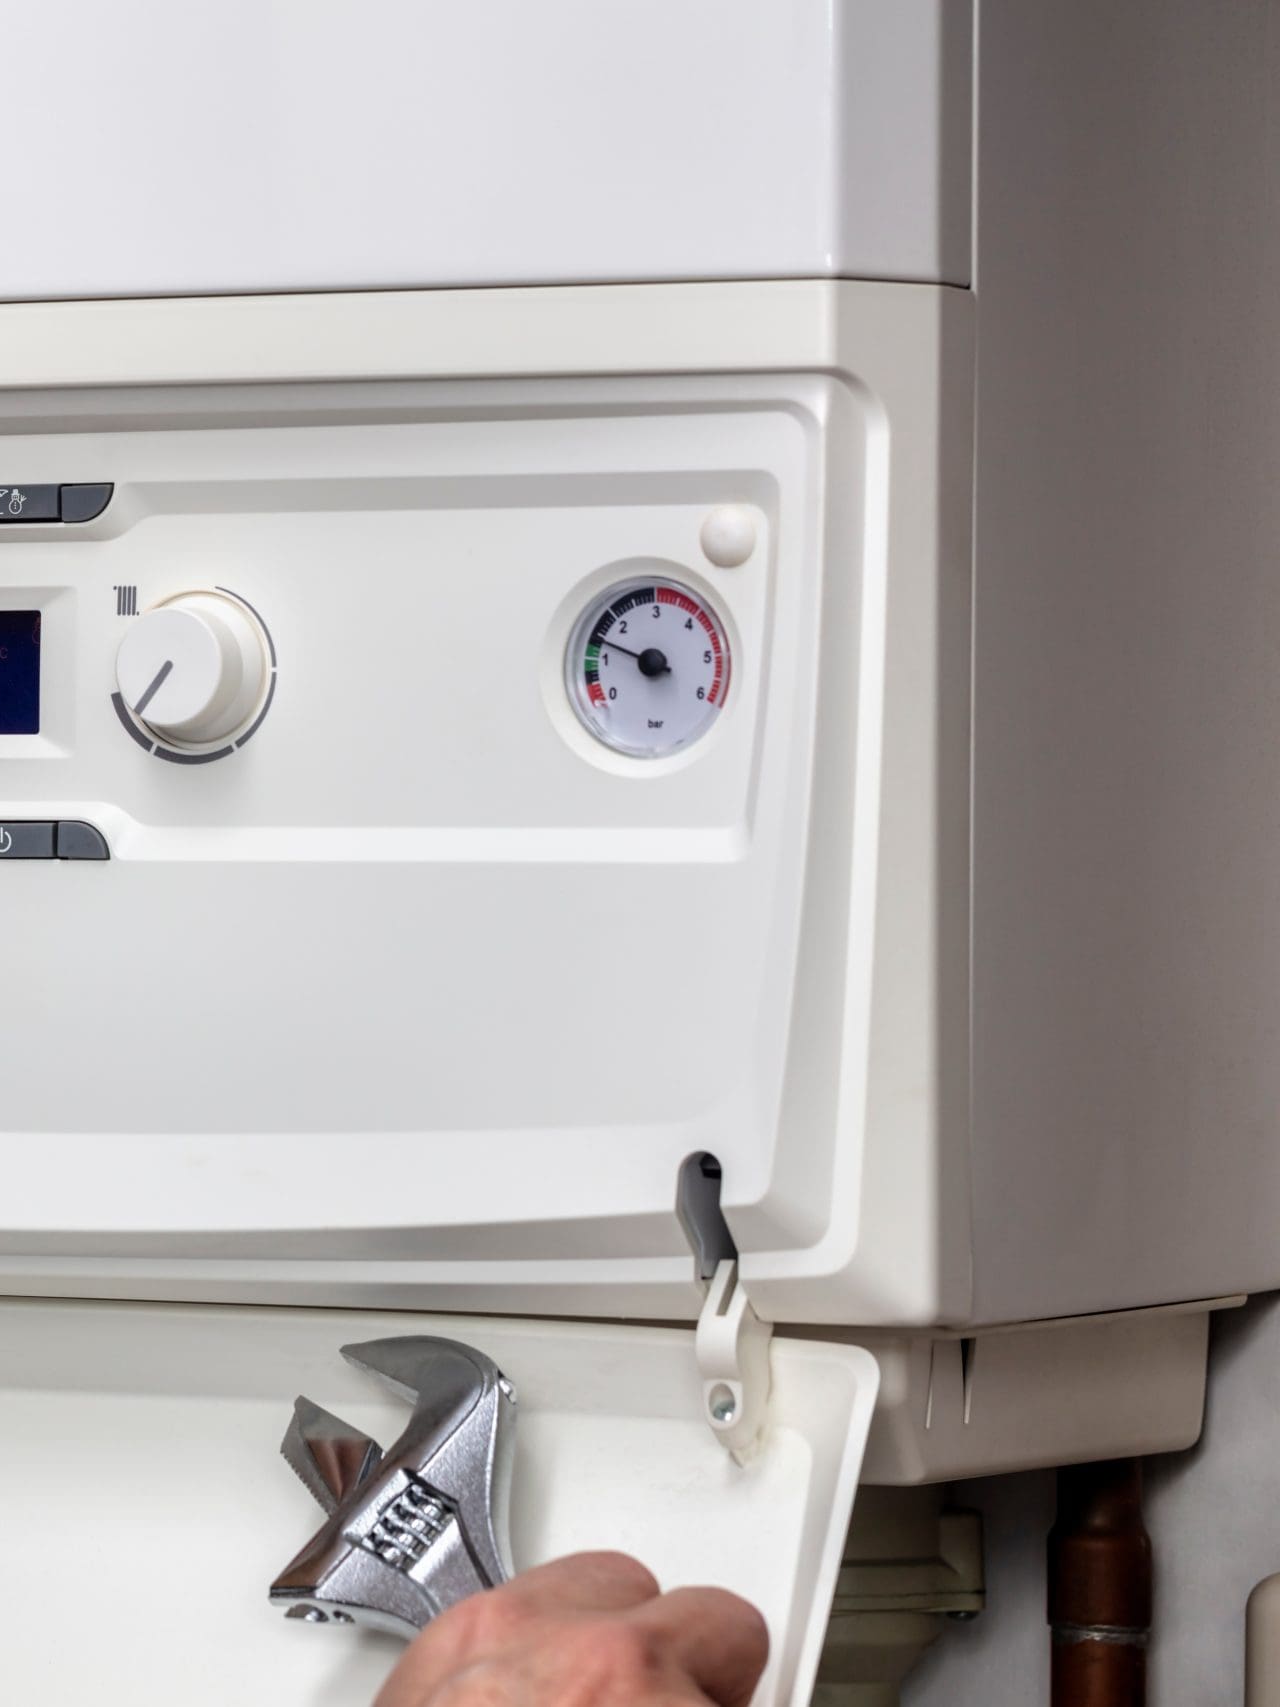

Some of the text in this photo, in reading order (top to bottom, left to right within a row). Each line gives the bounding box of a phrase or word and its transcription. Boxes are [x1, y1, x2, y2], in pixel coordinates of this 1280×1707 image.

[652, 605, 661, 618] 3
[620, 620, 628, 633] 2
[684, 617, 693, 630] 4
[602, 652, 608, 666] 1
[704, 650, 712, 663] 5
[609, 687, 617, 700] 0
[696, 687, 704, 699] 6
[648, 719, 664, 728] bar
